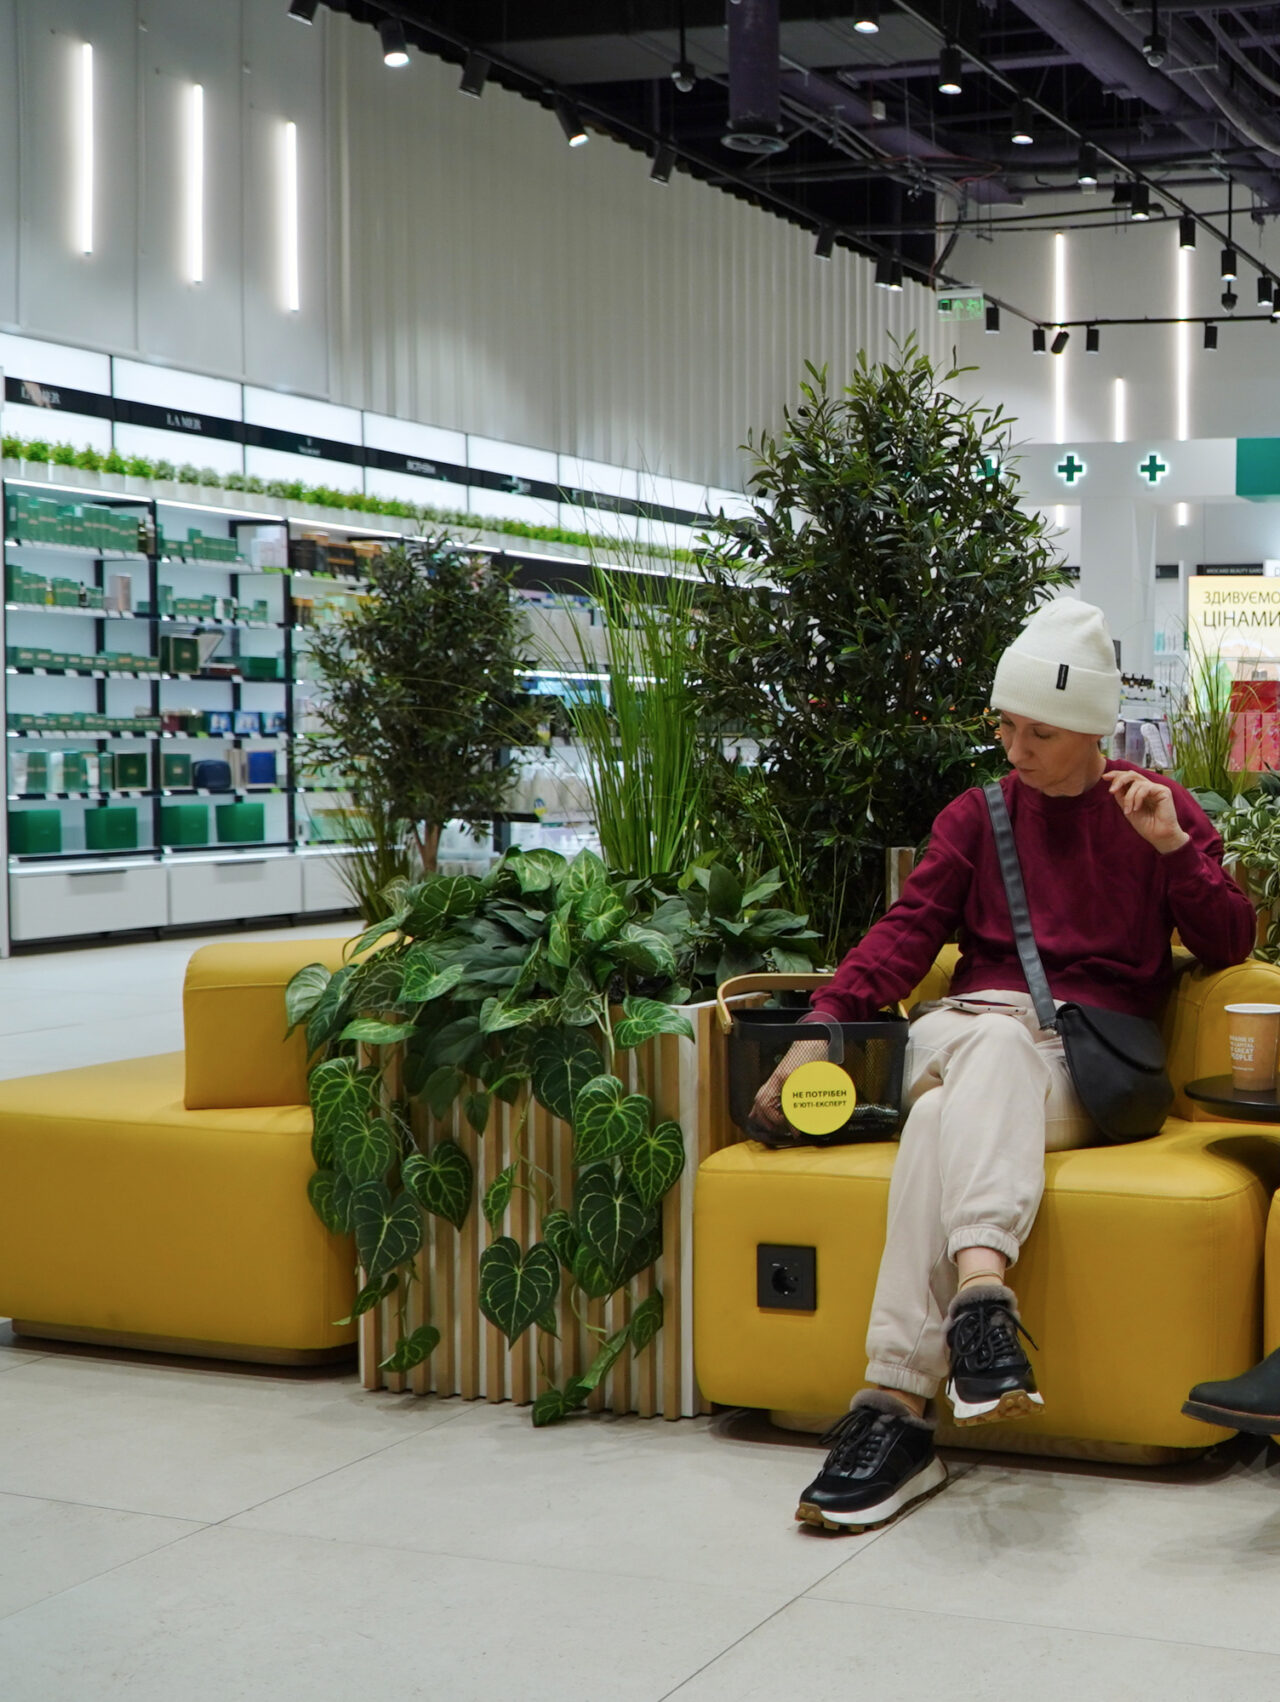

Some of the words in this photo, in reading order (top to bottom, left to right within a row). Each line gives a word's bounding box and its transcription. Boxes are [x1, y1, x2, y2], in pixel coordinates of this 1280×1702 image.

[166, 412, 180, 426] LA
[181, 415, 202, 430] MER
[792, 1091, 804, 1099] НЕ
[805, 1090, 847, 1098] ПОТРІБЕН
